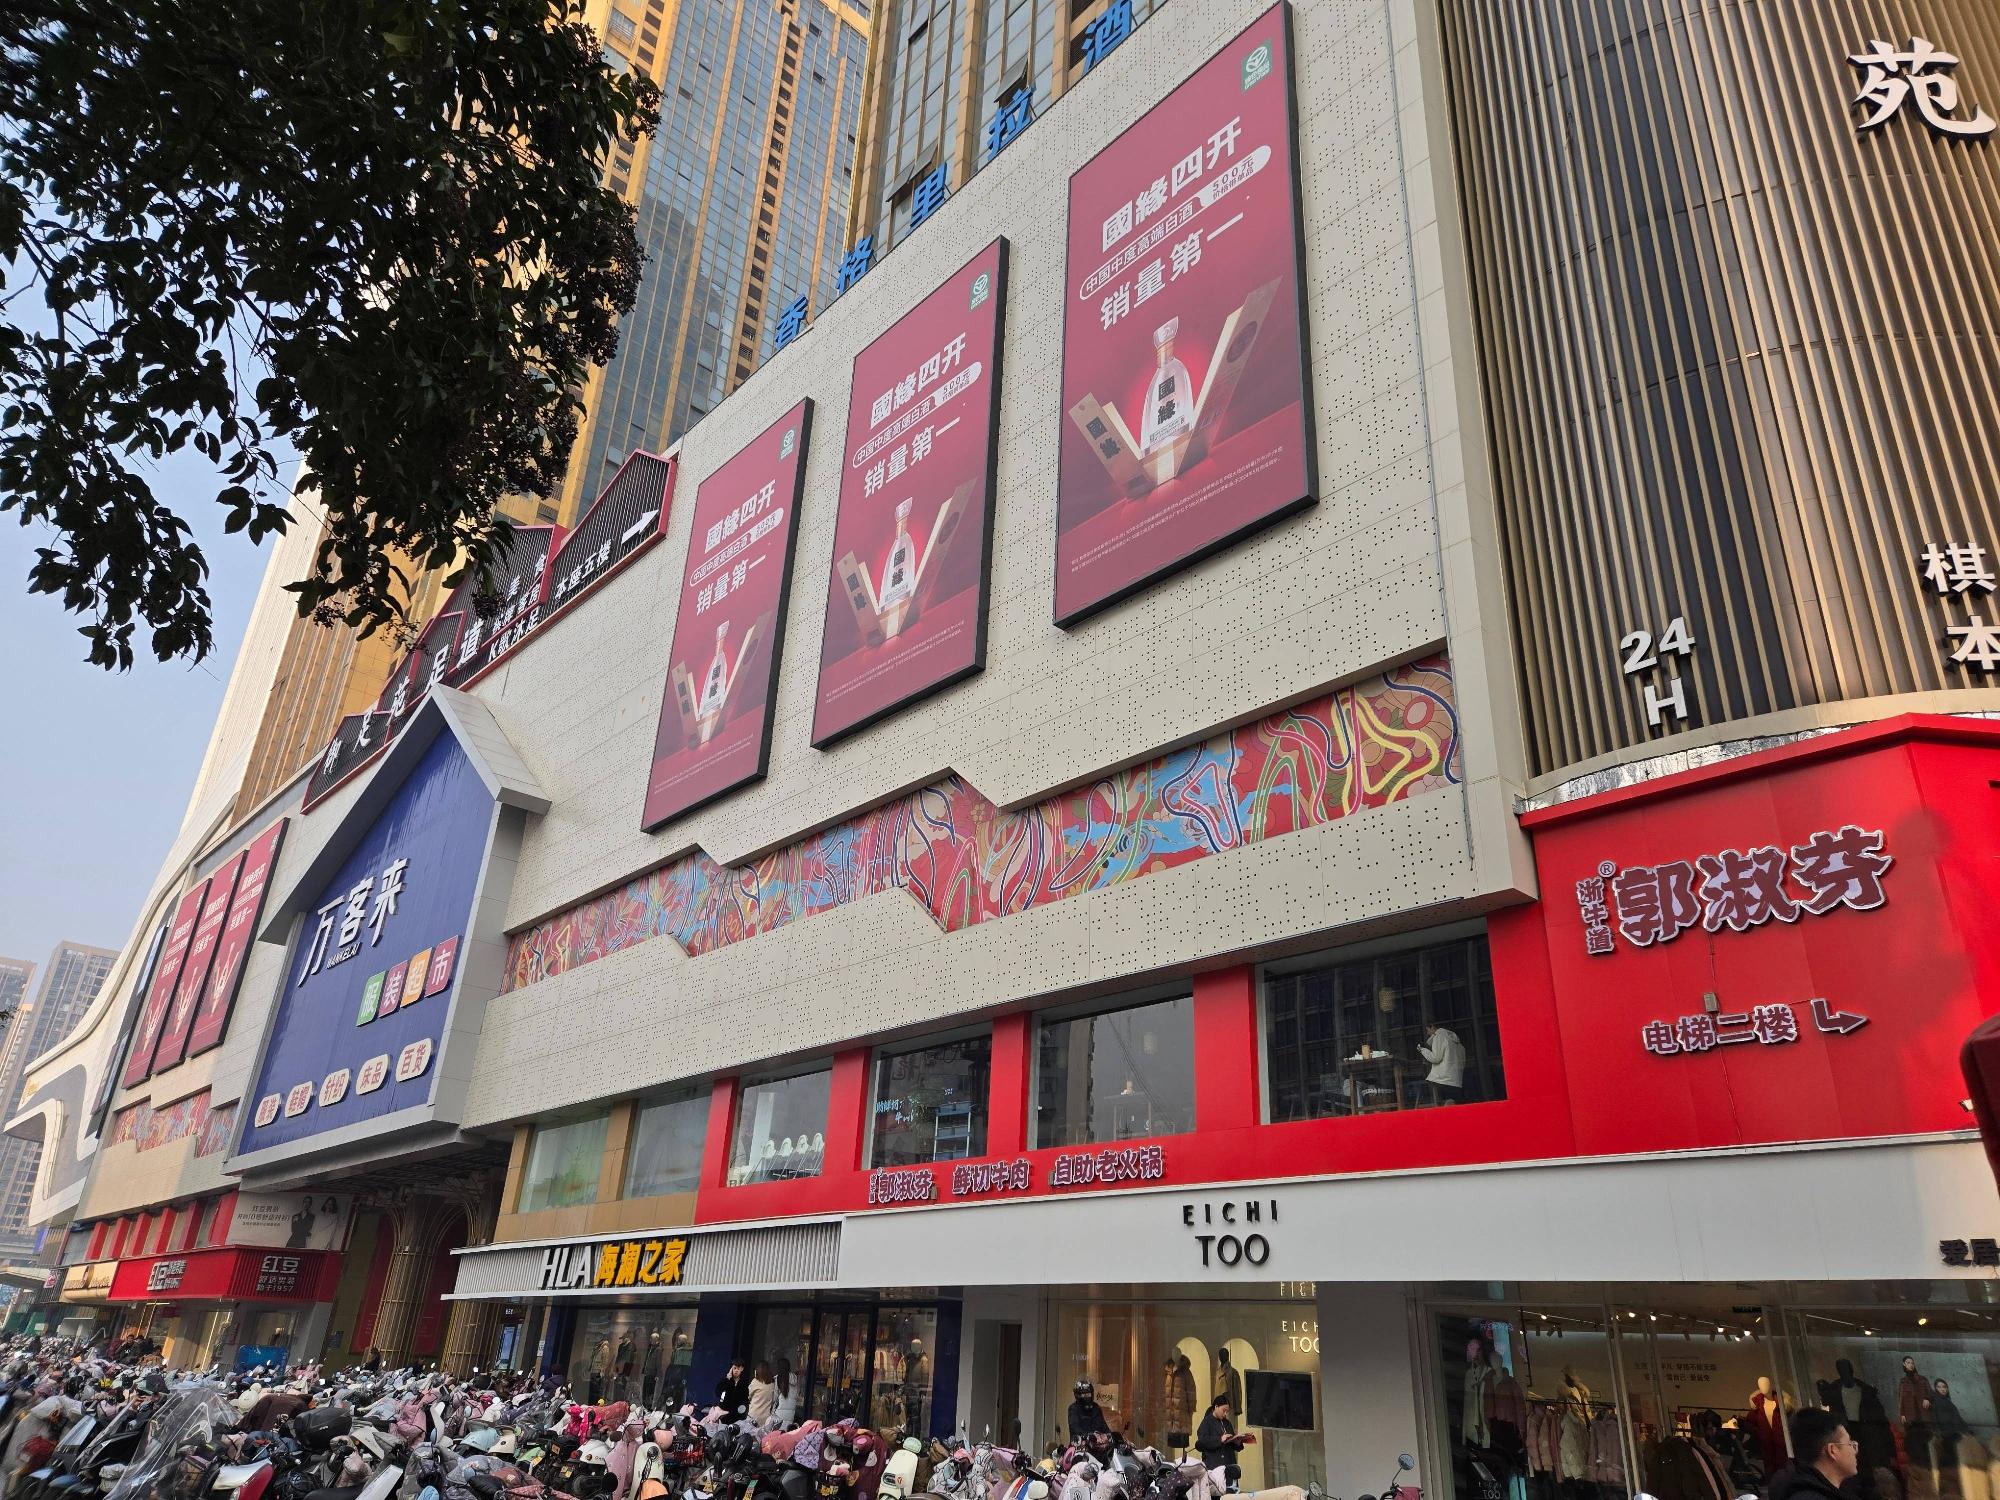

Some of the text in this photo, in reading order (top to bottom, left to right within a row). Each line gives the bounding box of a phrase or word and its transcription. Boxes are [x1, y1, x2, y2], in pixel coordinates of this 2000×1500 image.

[1846, 37, 1997, 134] 苑
[1086, 201, 1193, 293] 中国中度高端白酒
[1100, 212, 1244, 331] 销量第一
[864, 416, 961, 499] 销量第一
[696, 554, 766, 616] 销量第一
[1922, 542, 1997, 594] 棋
[1620, 616, 1695, 675] 24
[1947, 615, 2000, 670] 本
[1643, 677, 1688, 727] H
[1613, 825, 1894, 947] 郭淑芬
[297, 858, 409, 987] 万客来
[1576, 877, 1614, 955] 浙牛道
[1643, 1004, 1798, 1055] 电梯二楼
[952, 1158, 1030, 1195] 鲜切牛肉
[1054, 1145, 1163, 1186] 自助老火锅
[1182, 1199, 1279, 1227] EICHI
[261, 1255, 301, 1274] 红豆
[537, 1238, 687, 1289] HLA 海澜之家
[1194, 1233, 1271, 1267] TOO
